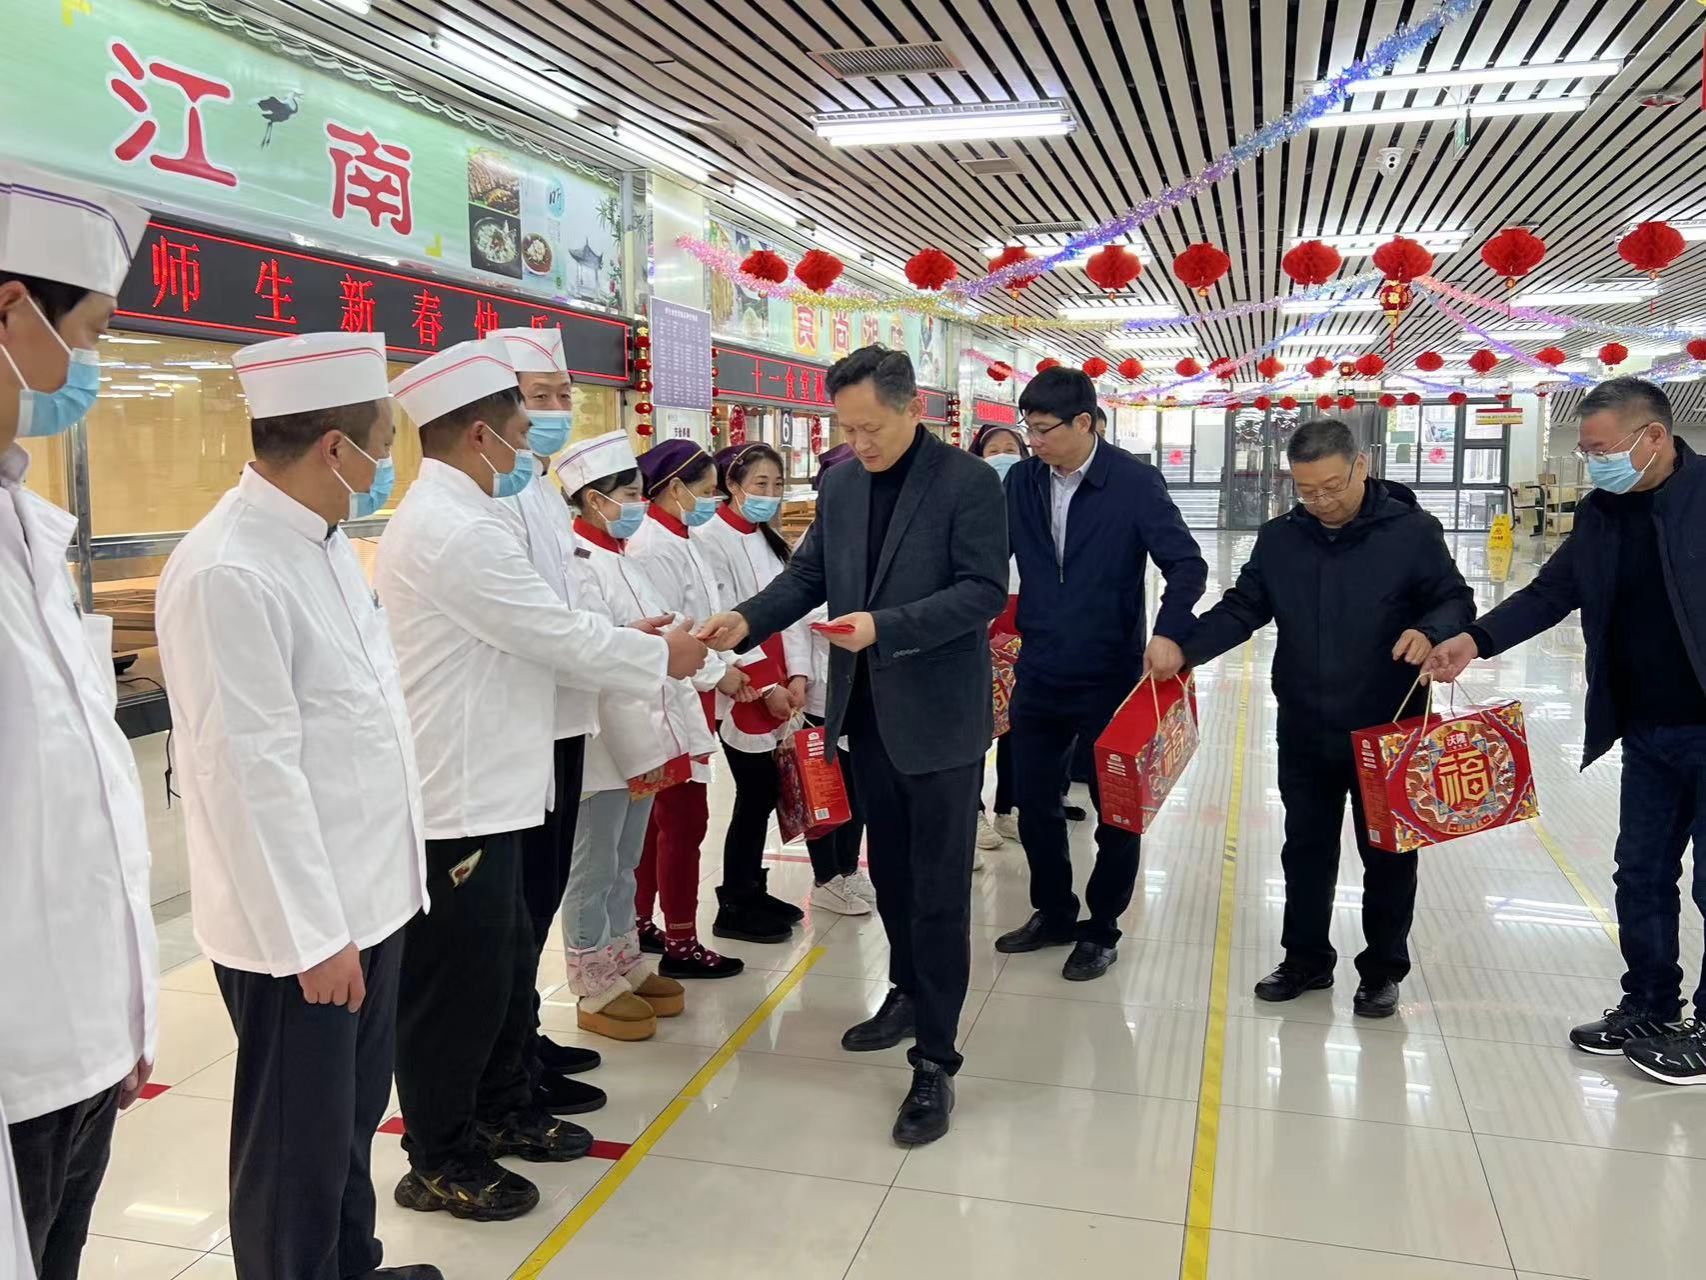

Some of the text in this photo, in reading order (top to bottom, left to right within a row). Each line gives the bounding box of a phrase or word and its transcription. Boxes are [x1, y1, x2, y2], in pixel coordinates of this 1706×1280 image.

[110, 42, 413, 236] 江南
[782, 413, 790, 442] 6
[1439, 750, 1490, 807] 福
